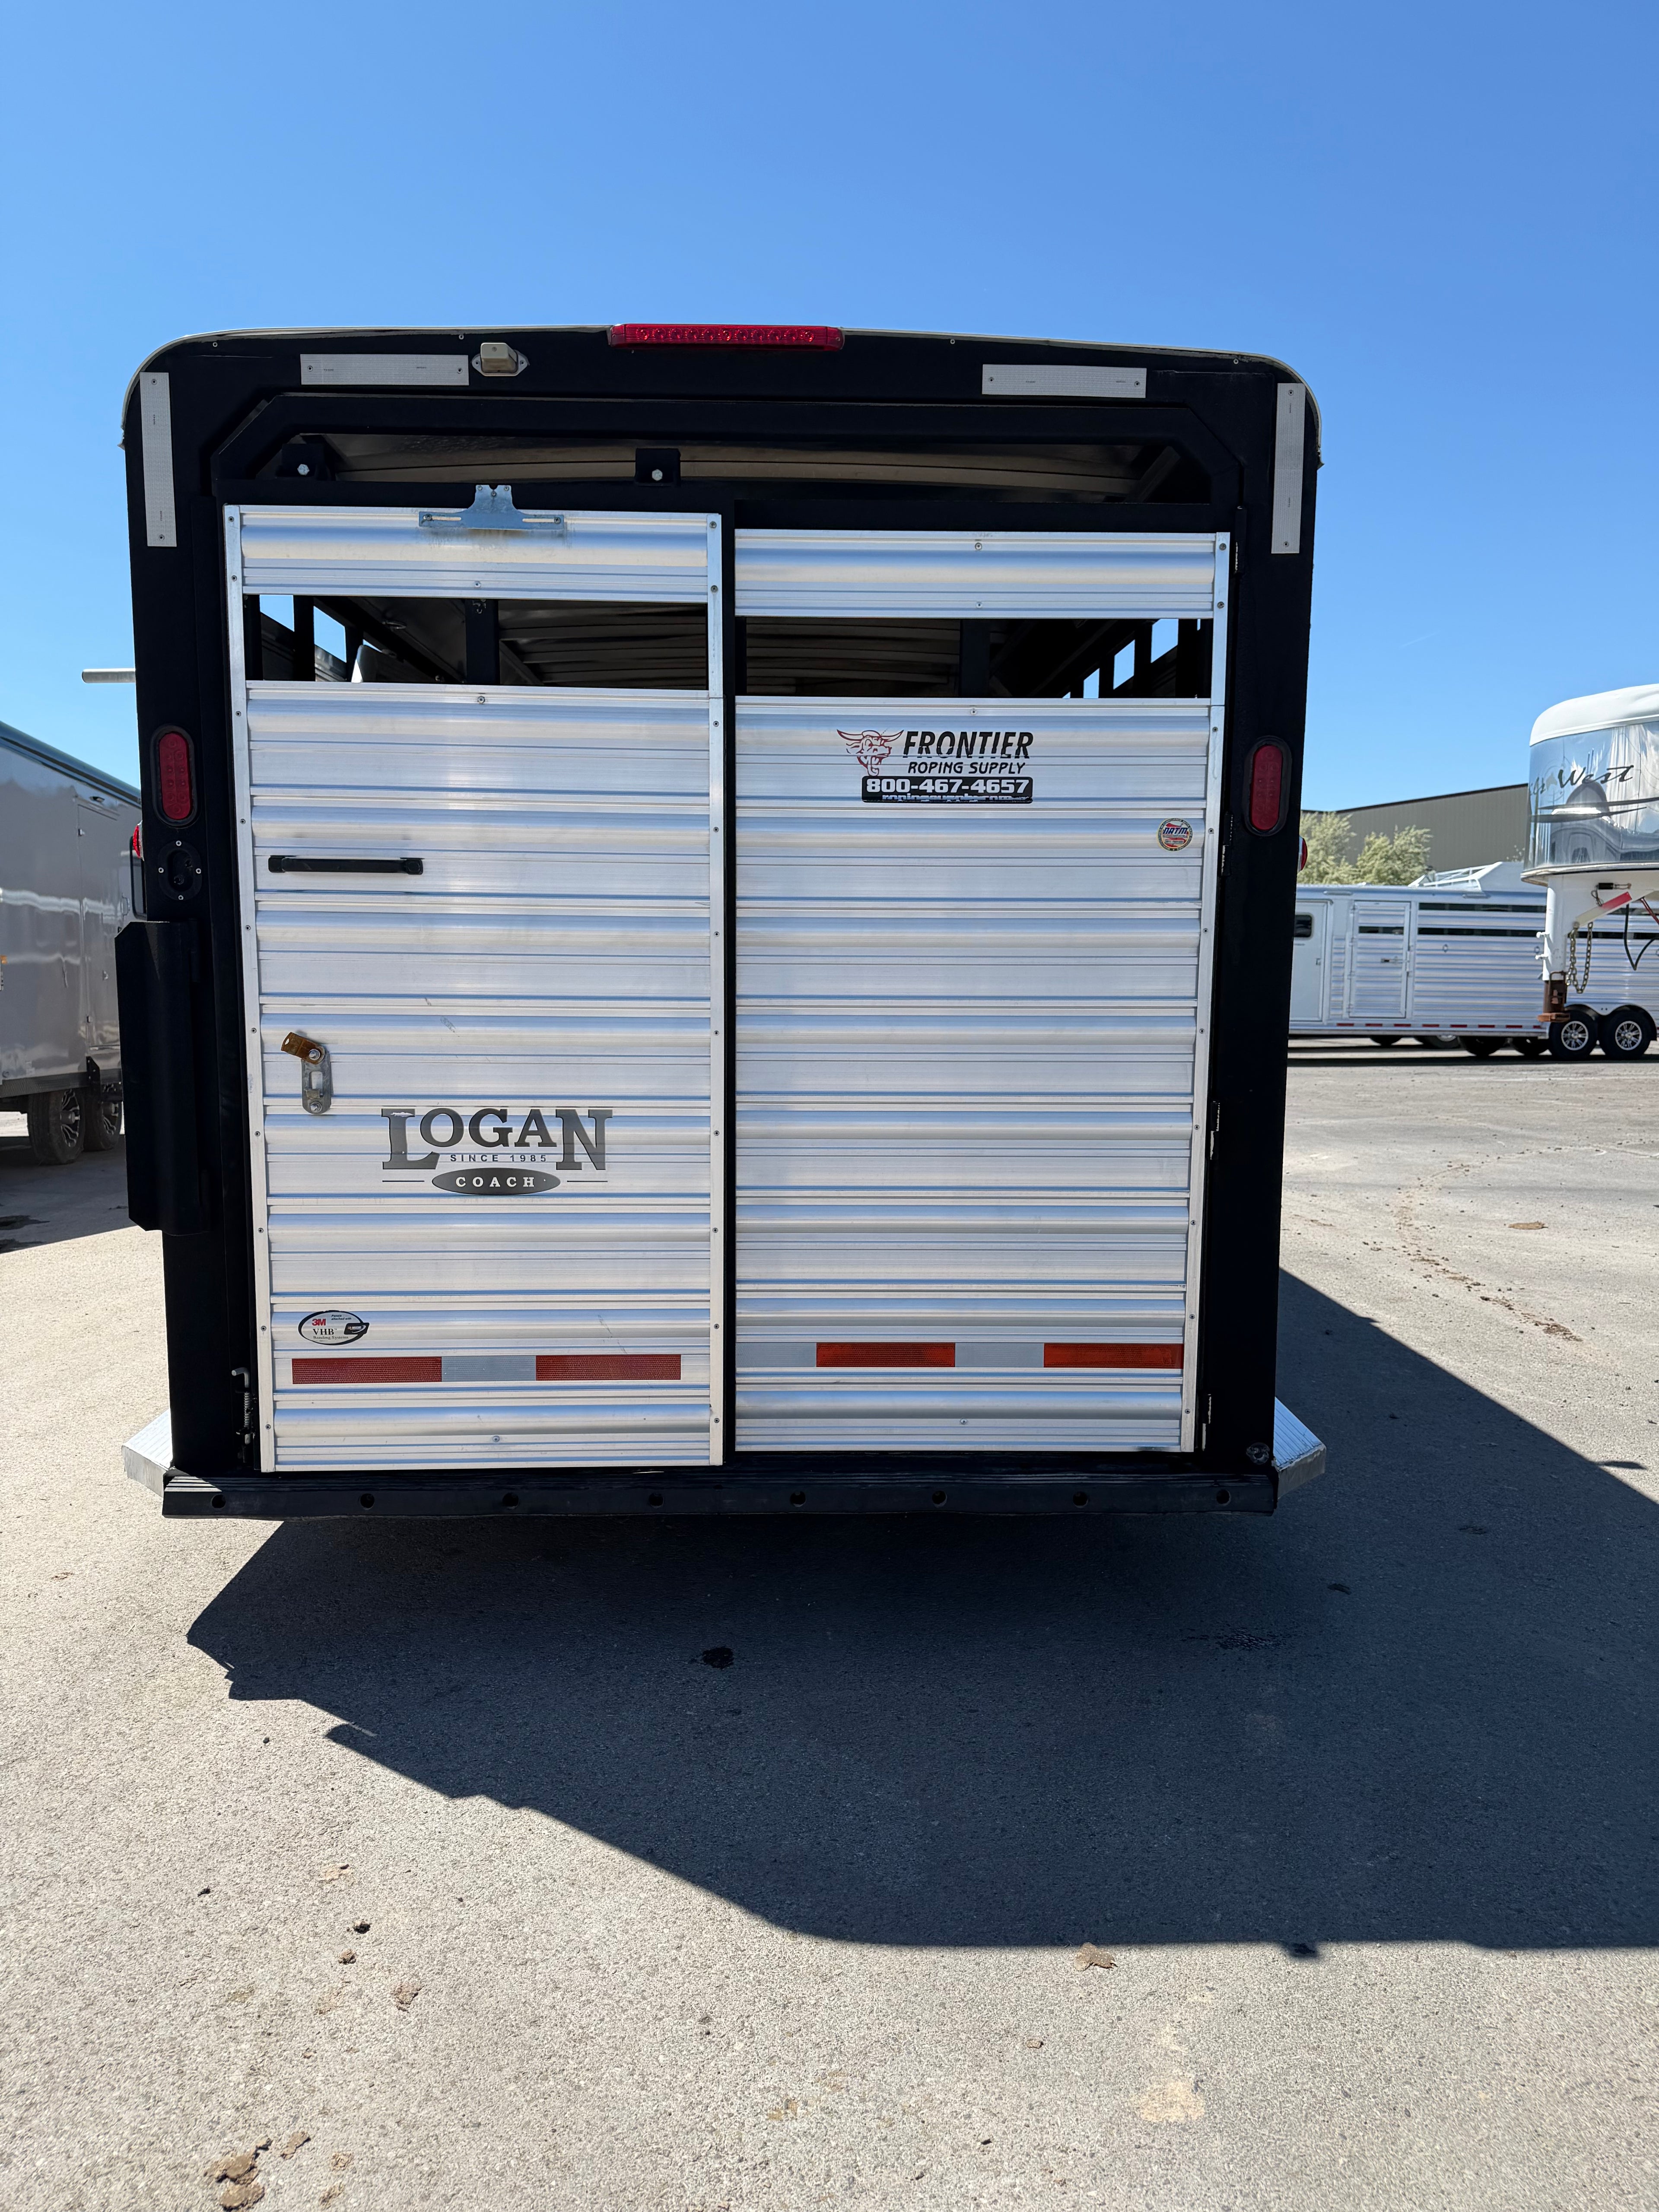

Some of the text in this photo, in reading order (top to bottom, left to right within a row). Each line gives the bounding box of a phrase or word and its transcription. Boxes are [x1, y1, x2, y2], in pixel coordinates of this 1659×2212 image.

[903, 731, 1033, 759] FRONTIER
[908, 762, 1026, 774] ROPING SUPPLY
[1557, 765, 1634, 788] West
[866, 779, 1030, 794] 800-467-4657
[381, 1108, 613, 1171] LOGAN
[450, 1154, 547, 1162] SINCE 1985
[455, 1176, 534, 1187] COACH
